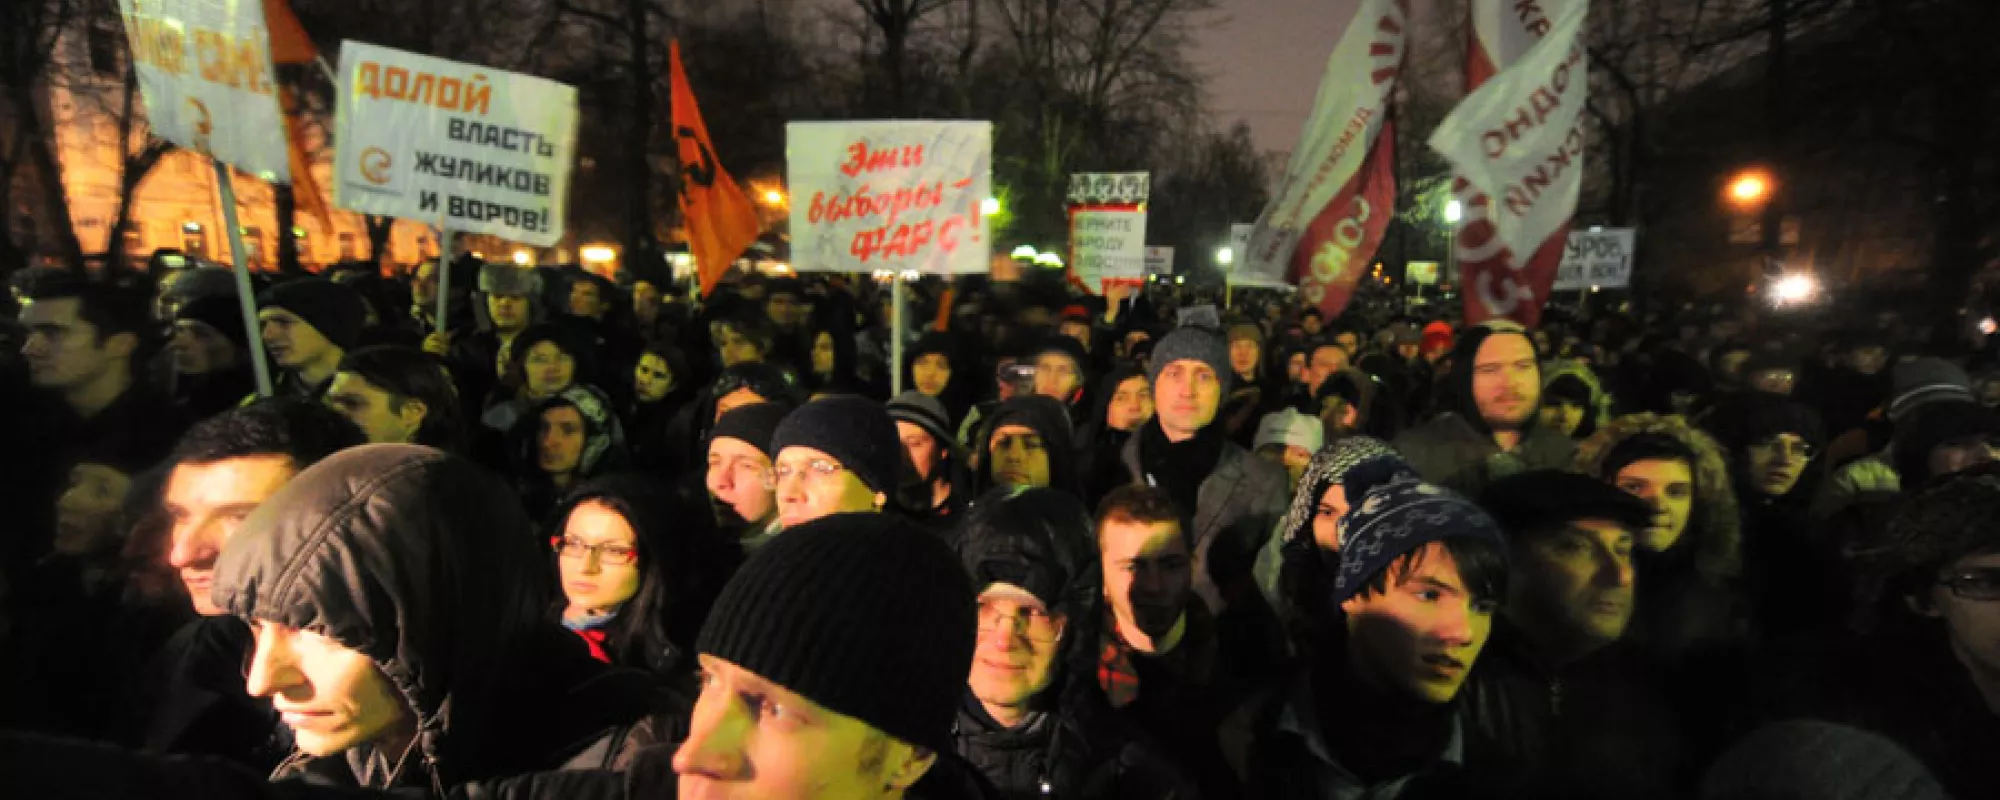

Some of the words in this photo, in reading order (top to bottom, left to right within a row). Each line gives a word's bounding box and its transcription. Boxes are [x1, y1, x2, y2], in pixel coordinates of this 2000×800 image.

[357, 61, 492, 115] ДОЛОЙ
[448, 118, 554, 157] ВЛАСТЬ
[413, 151, 551, 196] ЖУЛИКОВ
[419, 189, 439, 212] И
[448, 195, 550, 233] ВОРОВ!
